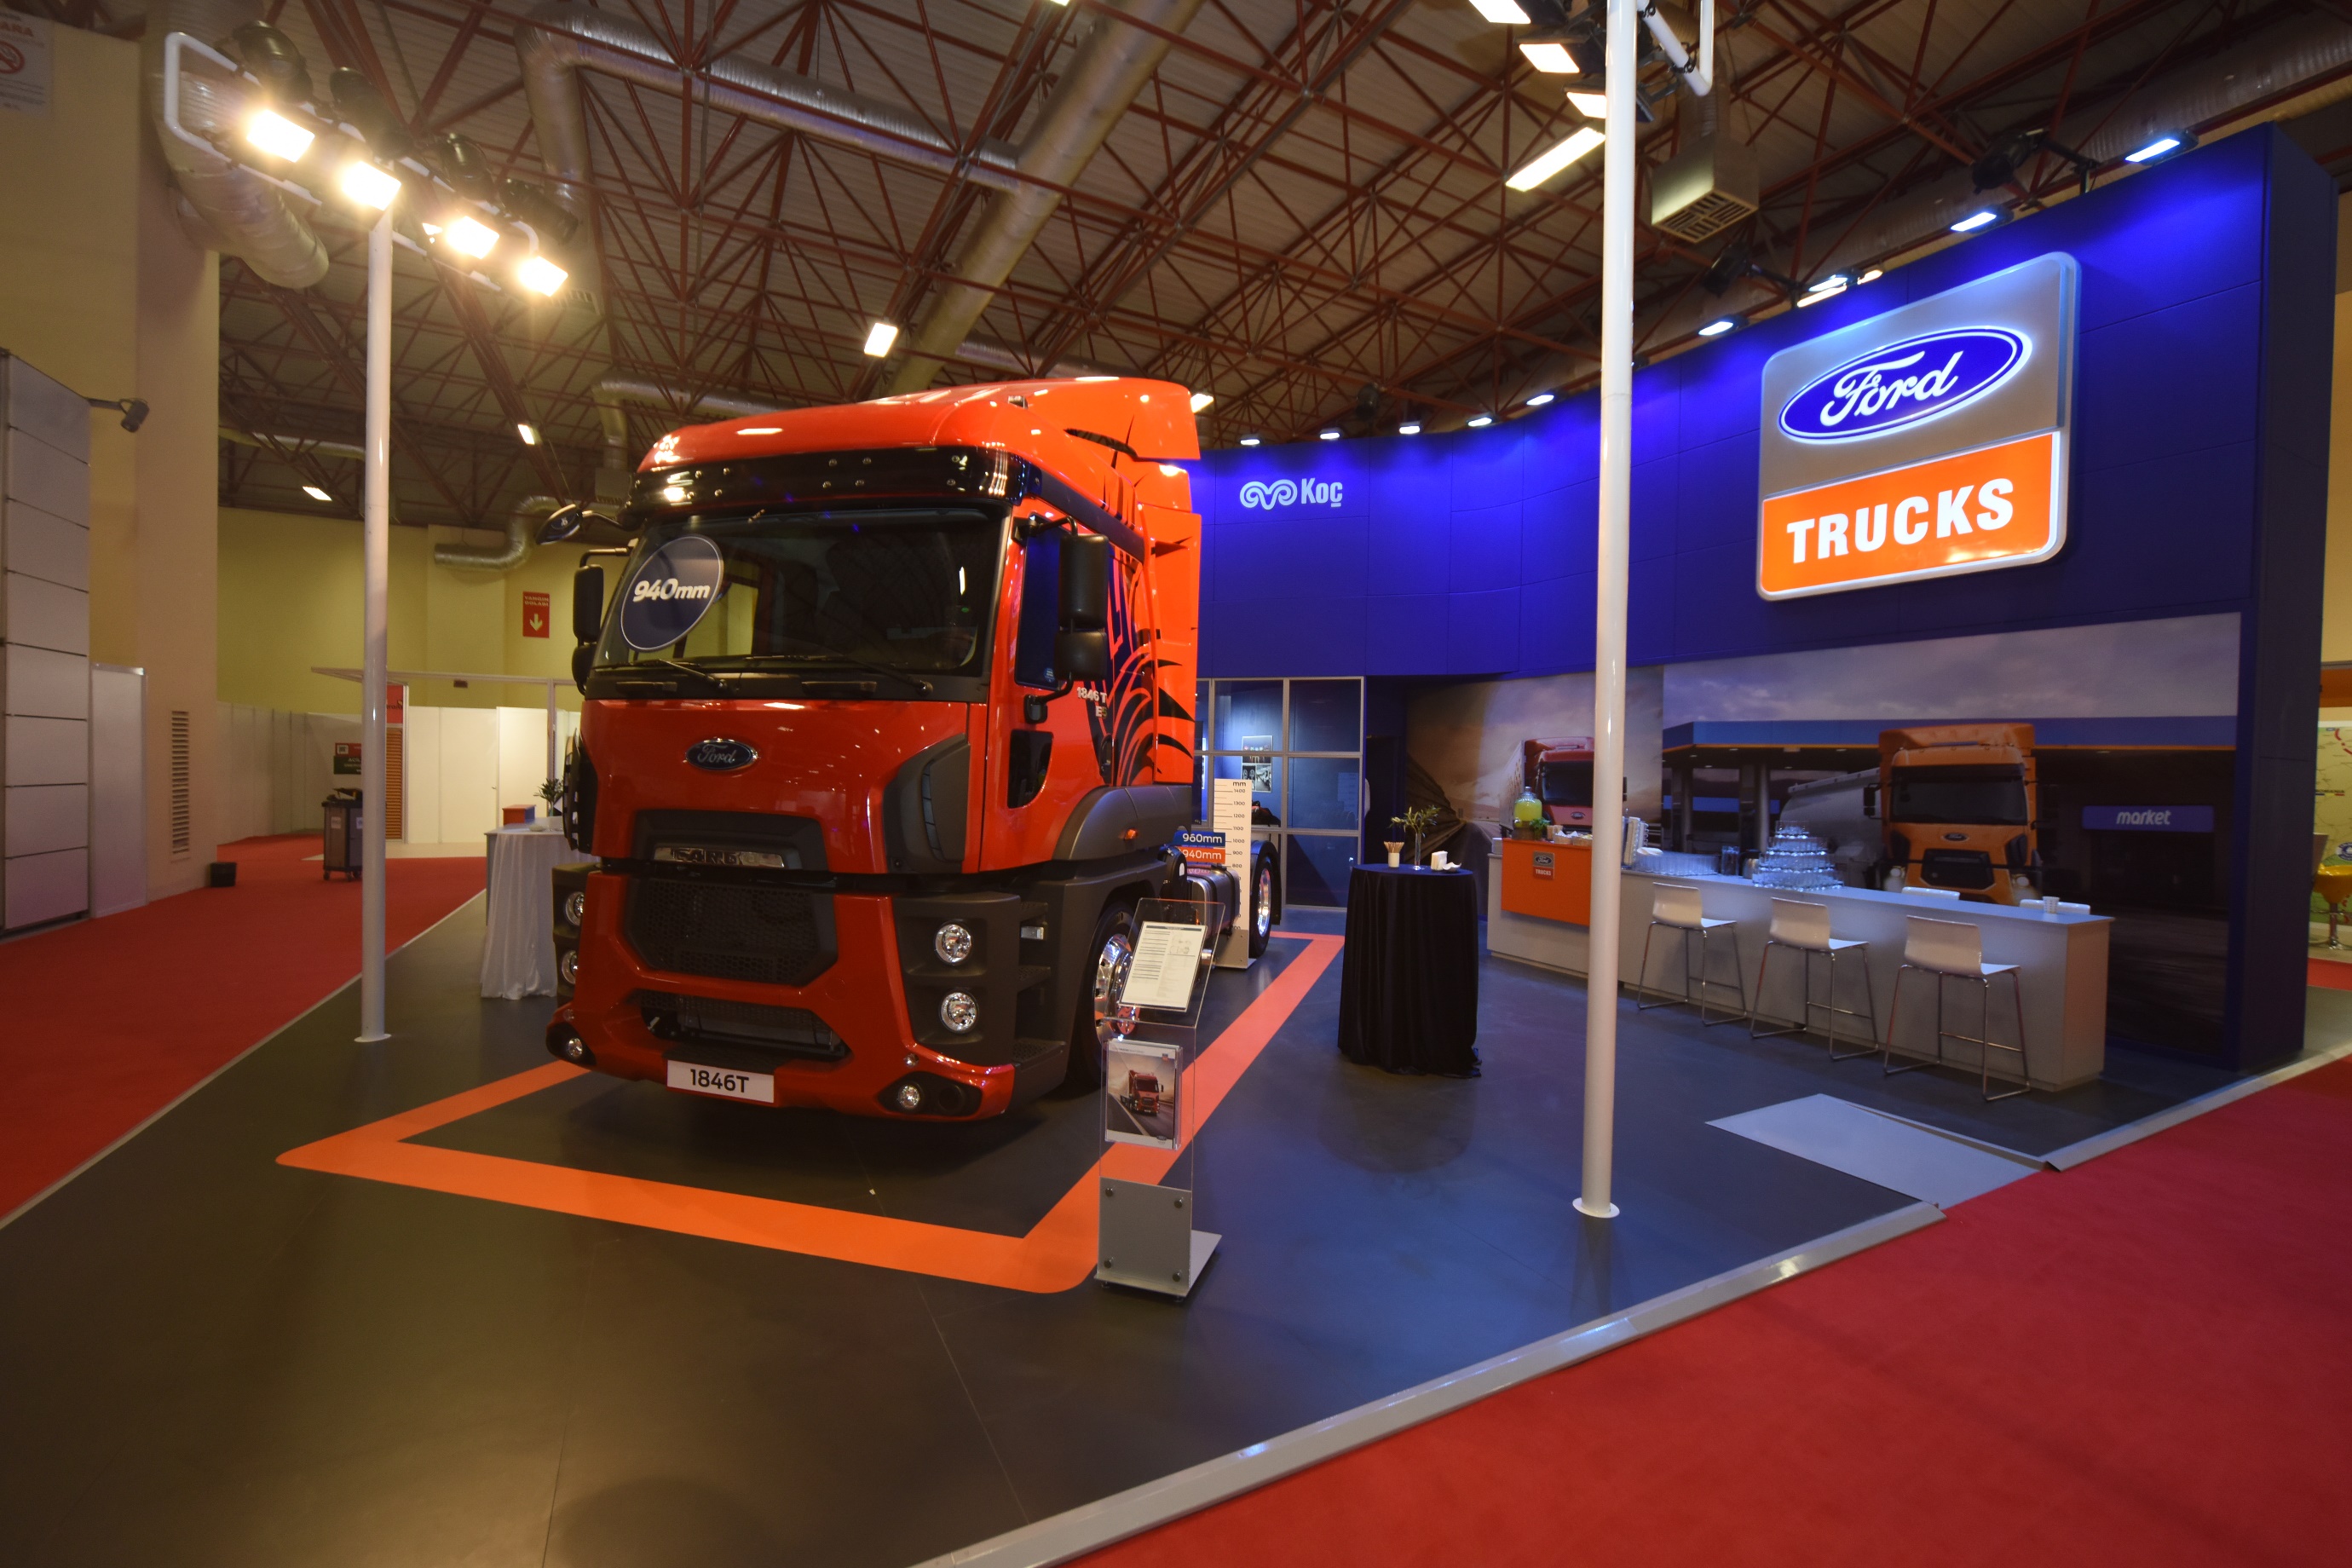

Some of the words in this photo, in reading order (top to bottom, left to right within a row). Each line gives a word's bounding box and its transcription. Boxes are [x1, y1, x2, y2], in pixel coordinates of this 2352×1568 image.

[1820, 350, 1963, 426] Ford
[1300, 477, 1343, 508] Koç
[1787, 478, 2014, 563] TRUCKS
[632, 578, 711, 602] 940mm
[1076, 687, 1099, 701] 1846
[1099, 691, 1107, 704] T
[697, 744, 738, 764] Ford
[2116, 810, 2171, 825] market
[1182, 833, 1223, 844] 960mm
[1183, 850, 1222, 860] 940mm
[689, 1068, 750, 1093] 1846T
